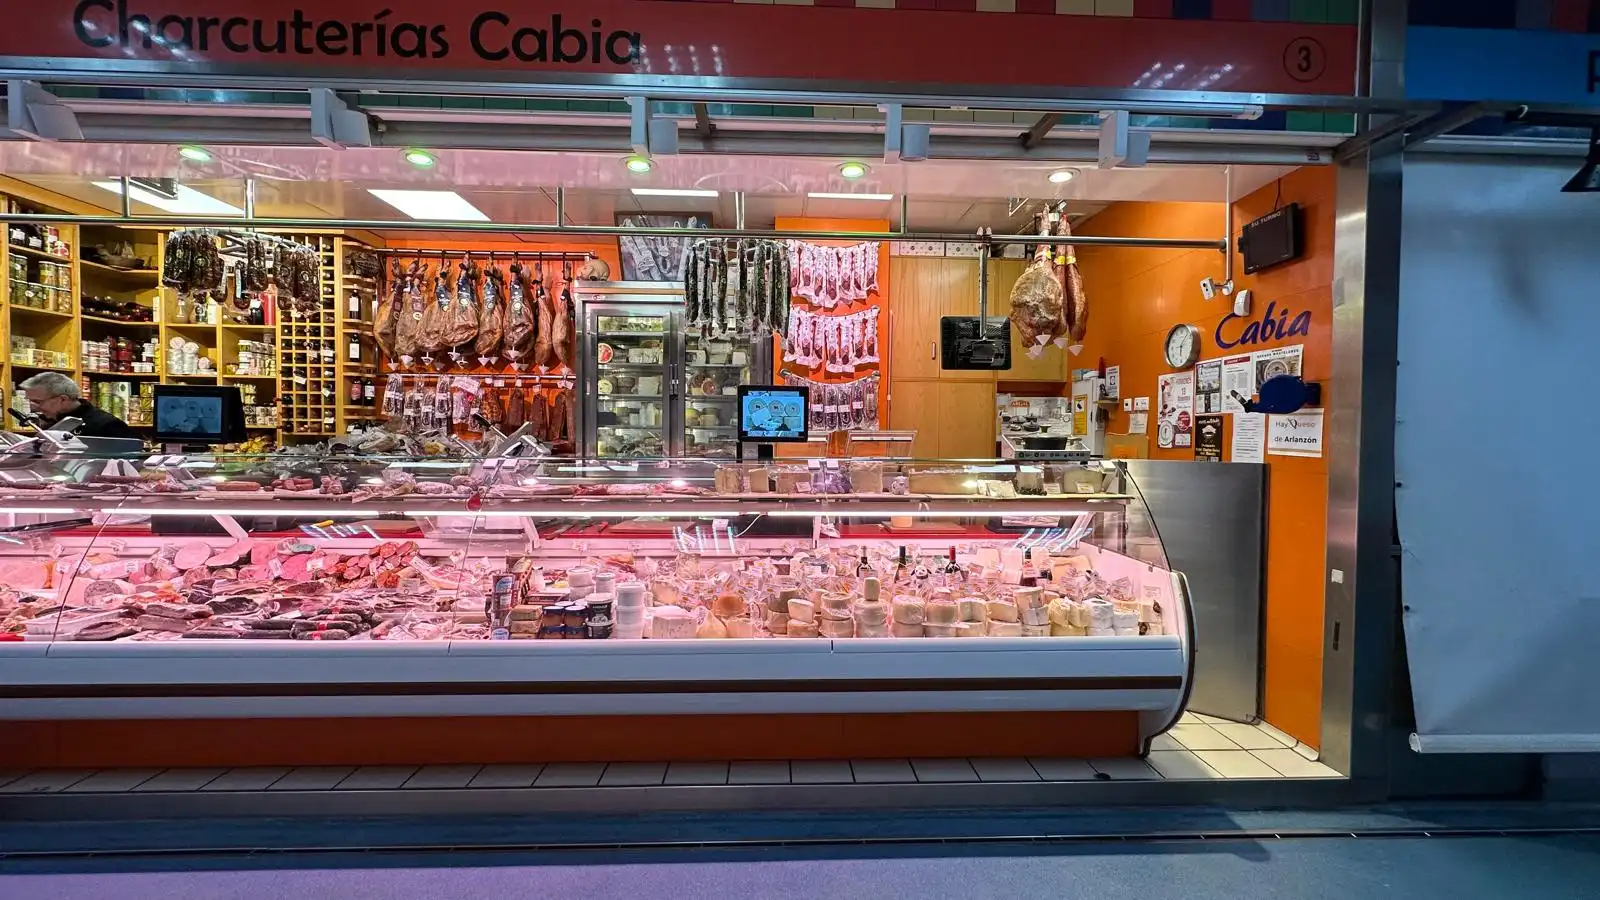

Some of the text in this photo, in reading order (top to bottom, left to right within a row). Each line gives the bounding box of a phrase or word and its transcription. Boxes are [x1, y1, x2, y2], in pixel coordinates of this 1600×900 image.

[73, 0, 642, 66] Charcuterías Cabia
[1297, 45, 1312, 73] 3
[1215, 301, 1312, 349] Cabia
[1275, 421, 1288, 429] Hay
[1284, 436, 1317, 444] Arlanzón
